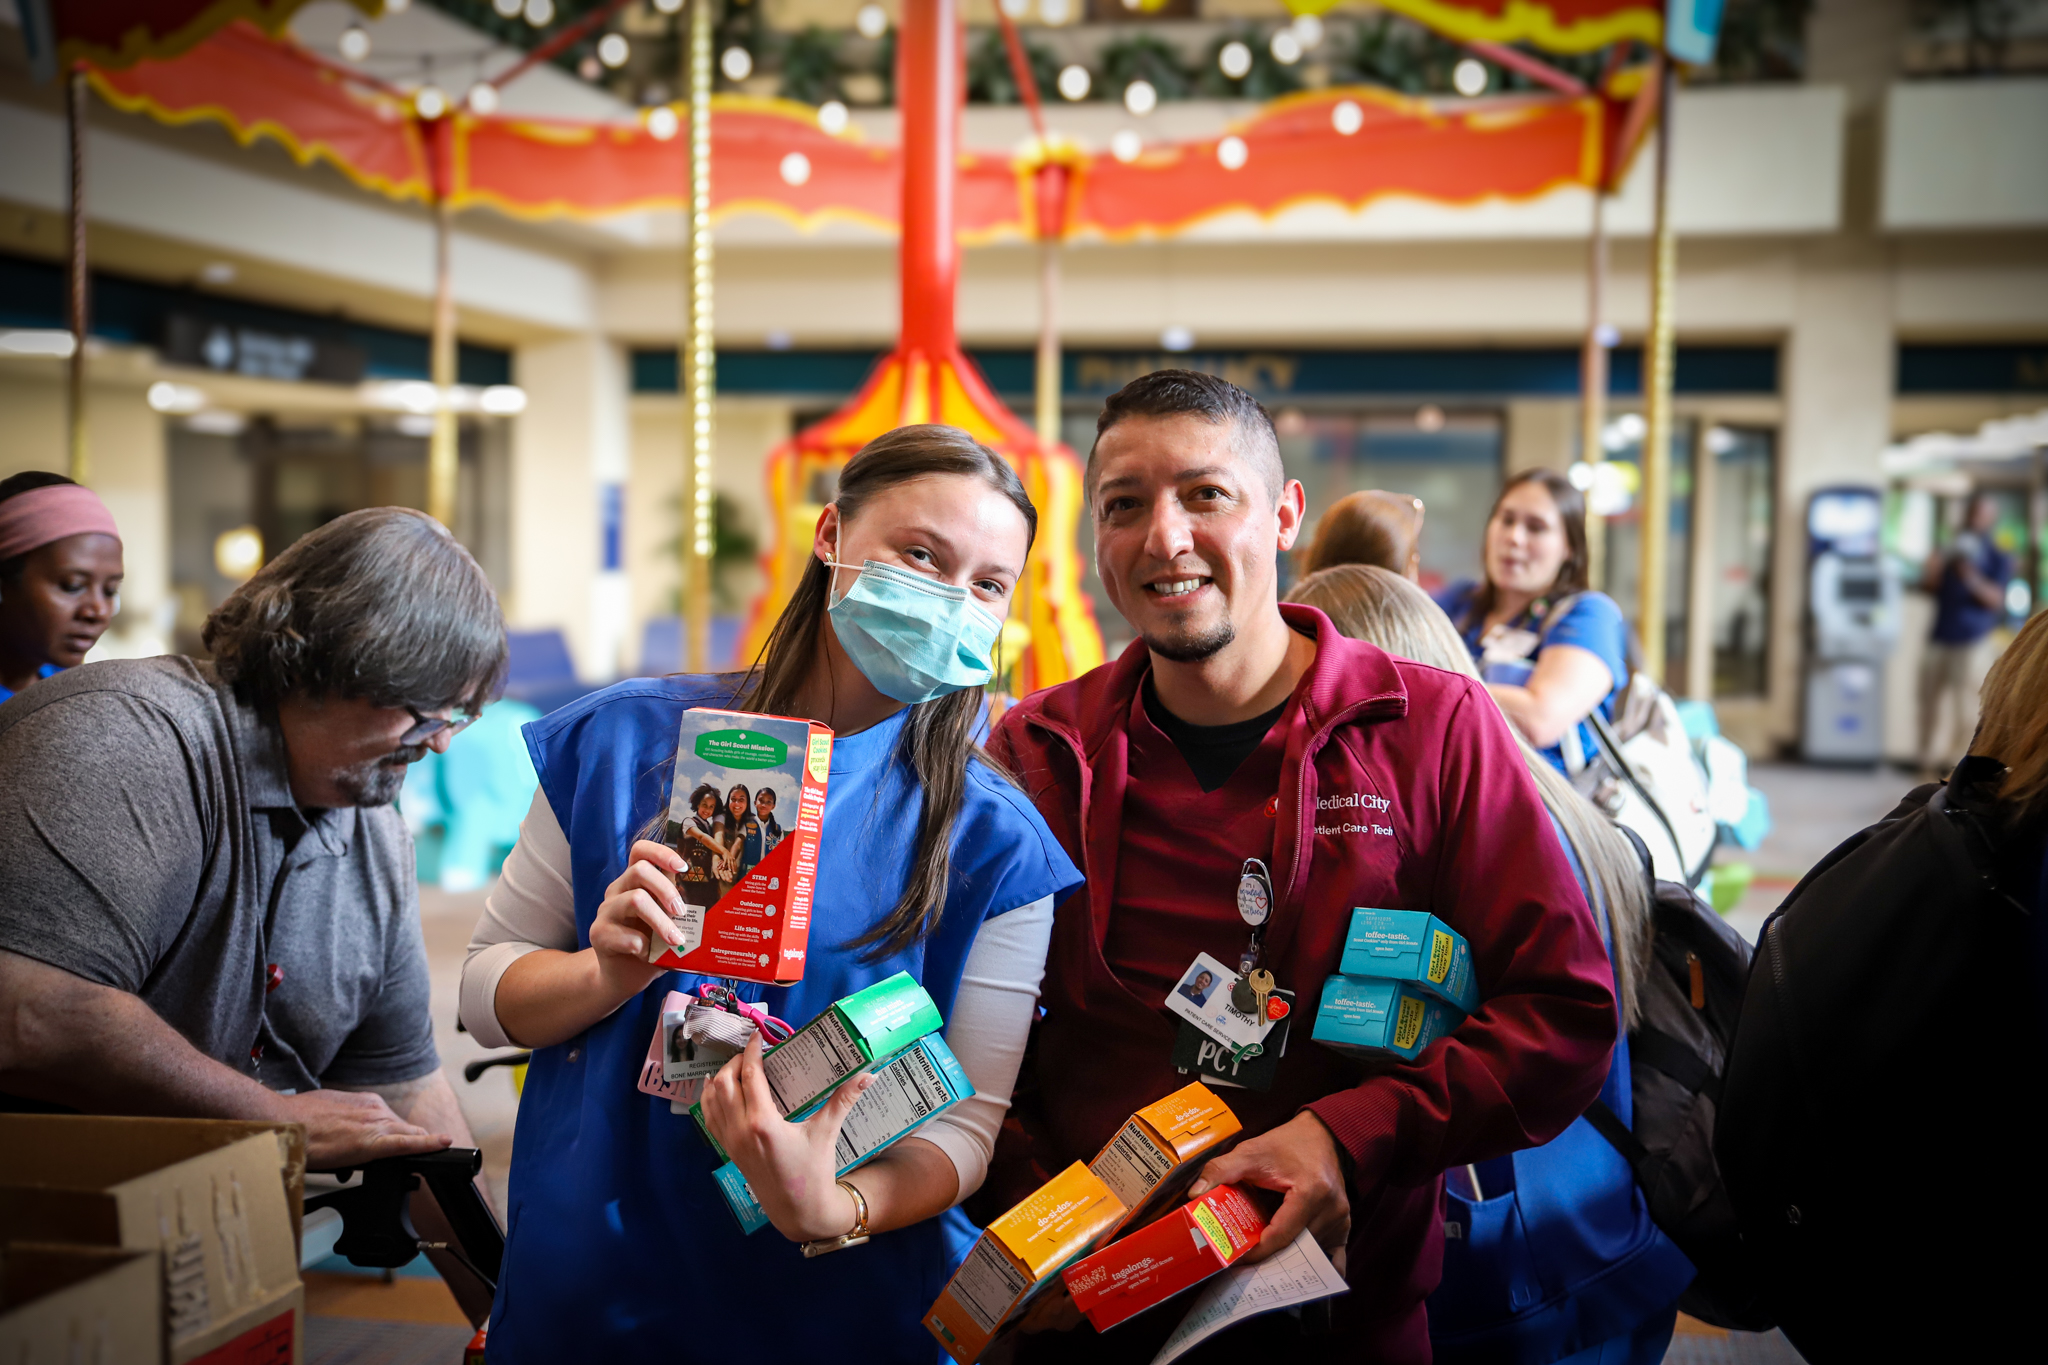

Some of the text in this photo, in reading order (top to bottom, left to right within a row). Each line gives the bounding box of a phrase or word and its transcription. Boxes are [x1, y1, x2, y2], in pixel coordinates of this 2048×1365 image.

[1361, 794, 1390, 813] City
[1314, 823, 1394, 836] atient Care Tech
[711, 947, 757, 959] Entrepreneurship
[1431, 934, 1441, 958] Scout
[1185, 1008, 1202, 1022] PATIENT
[1201, 1020, 1213, 1030] CARE
[1224, 1003, 1255, 1027] TIMOTHY
[1399, 1000, 1408, 1024] Scout
[826, 1012, 864, 1065] Nutrition Facts
[809, 1026, 846, 1077] Calories 160
[910, 1046, 939, 1081] Nutrition
[931, 1080, 951, 1103] Facts
[889, 1062, 928, 1117] Calories 140
[1127, 1122, 1172, 1170] Nutrition Facts
[1114, 1140, 1158, 1186] Calories 160
[1054, 1217, 1074, 1234] open here
[982, 1236, 1028, 1285] Nutrition Facts
[1097, 1286, 1111, 1296] Scout
[1129, 1272, 1140, 1281] only
[1139, 1267, 1151, 1276] from
[1149, 1262, 1159, 1270] Girl
[1158, 1255, 1174, 1266] Scouts
[1128, 1275, 1150, 1290] open here
